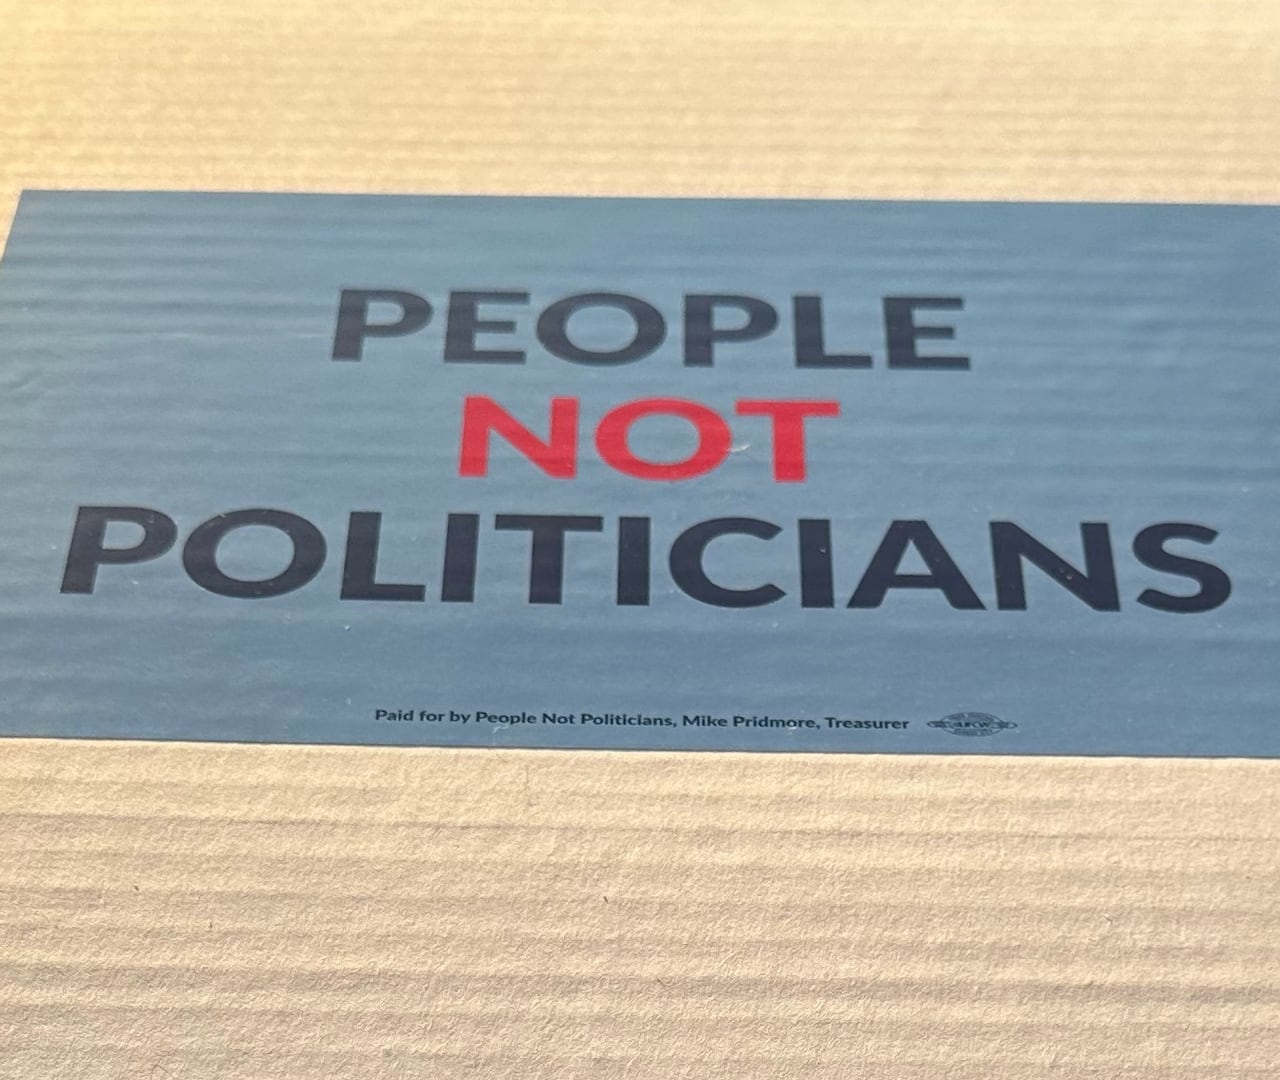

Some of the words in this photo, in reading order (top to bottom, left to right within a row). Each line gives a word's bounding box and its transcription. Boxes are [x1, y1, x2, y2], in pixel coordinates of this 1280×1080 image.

[332, 288, 971, 372] PEOPLE
[459, 395, 840, 482] NOT
[60, 504, 1233, 615] POLITICIANS
[375, 709, 415, 722] Paid
[419, 710, 446, 722] for
[450, 711, 471, 724] by
[475, 711, 537, 725] People
[542, 712, 576, 725] Not
[580, 713, 677, 728] Politicians,
[682, 715, 728, 727] Mike
[732, 715, 821, 730] Pridmore,
[824, 716, 910, 730] Treasurer
